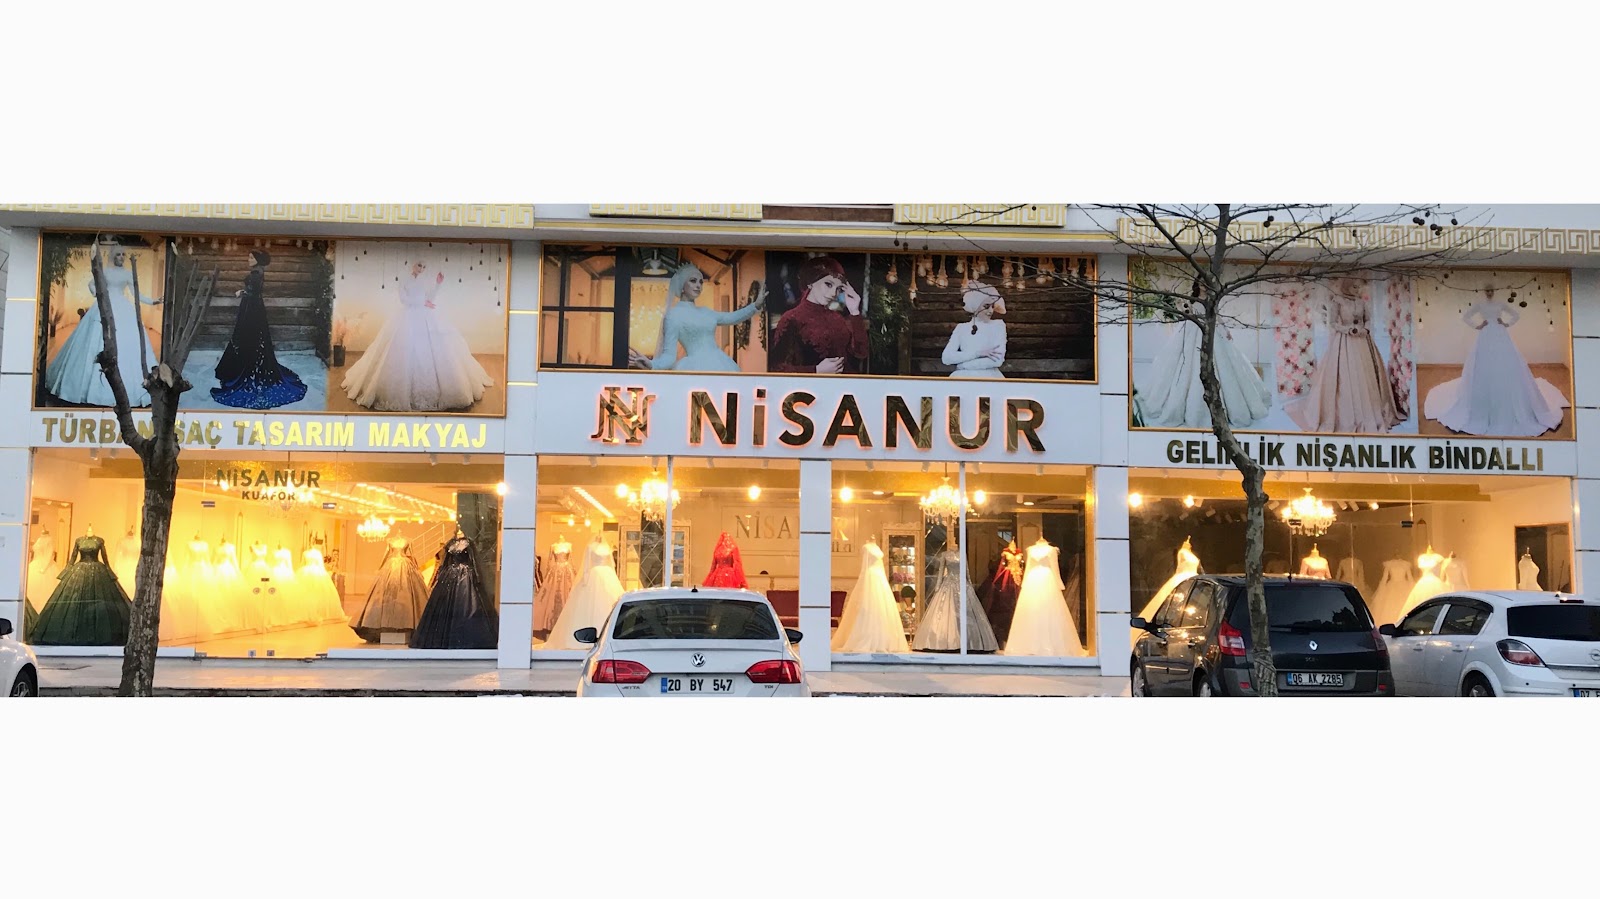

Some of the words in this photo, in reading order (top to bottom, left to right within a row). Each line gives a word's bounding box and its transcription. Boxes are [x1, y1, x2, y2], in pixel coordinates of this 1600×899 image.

[42, 412, 154, 444] TÜRBN
[233, 420, 355, 447] TASARIM
[368, 421, 487, 448] MAKYAJ
[689, 388, 1046, 452] NiSANUR
[1167, 436, 1286, 466] GELİLİK
[1296, 437, 1417, 471] NİŞANLIK
[1429, 440, 1544, 472] BİNDALLI
[216, 468, 321, 488] NiSANUR
[668, 679, 681, 692] 20
[690, 679, 704, 692] BY
[713, 679, 733, 692] 547
[1308, 673, 1319, 684] AK
[1321, 674, 1342, 684] 2285
